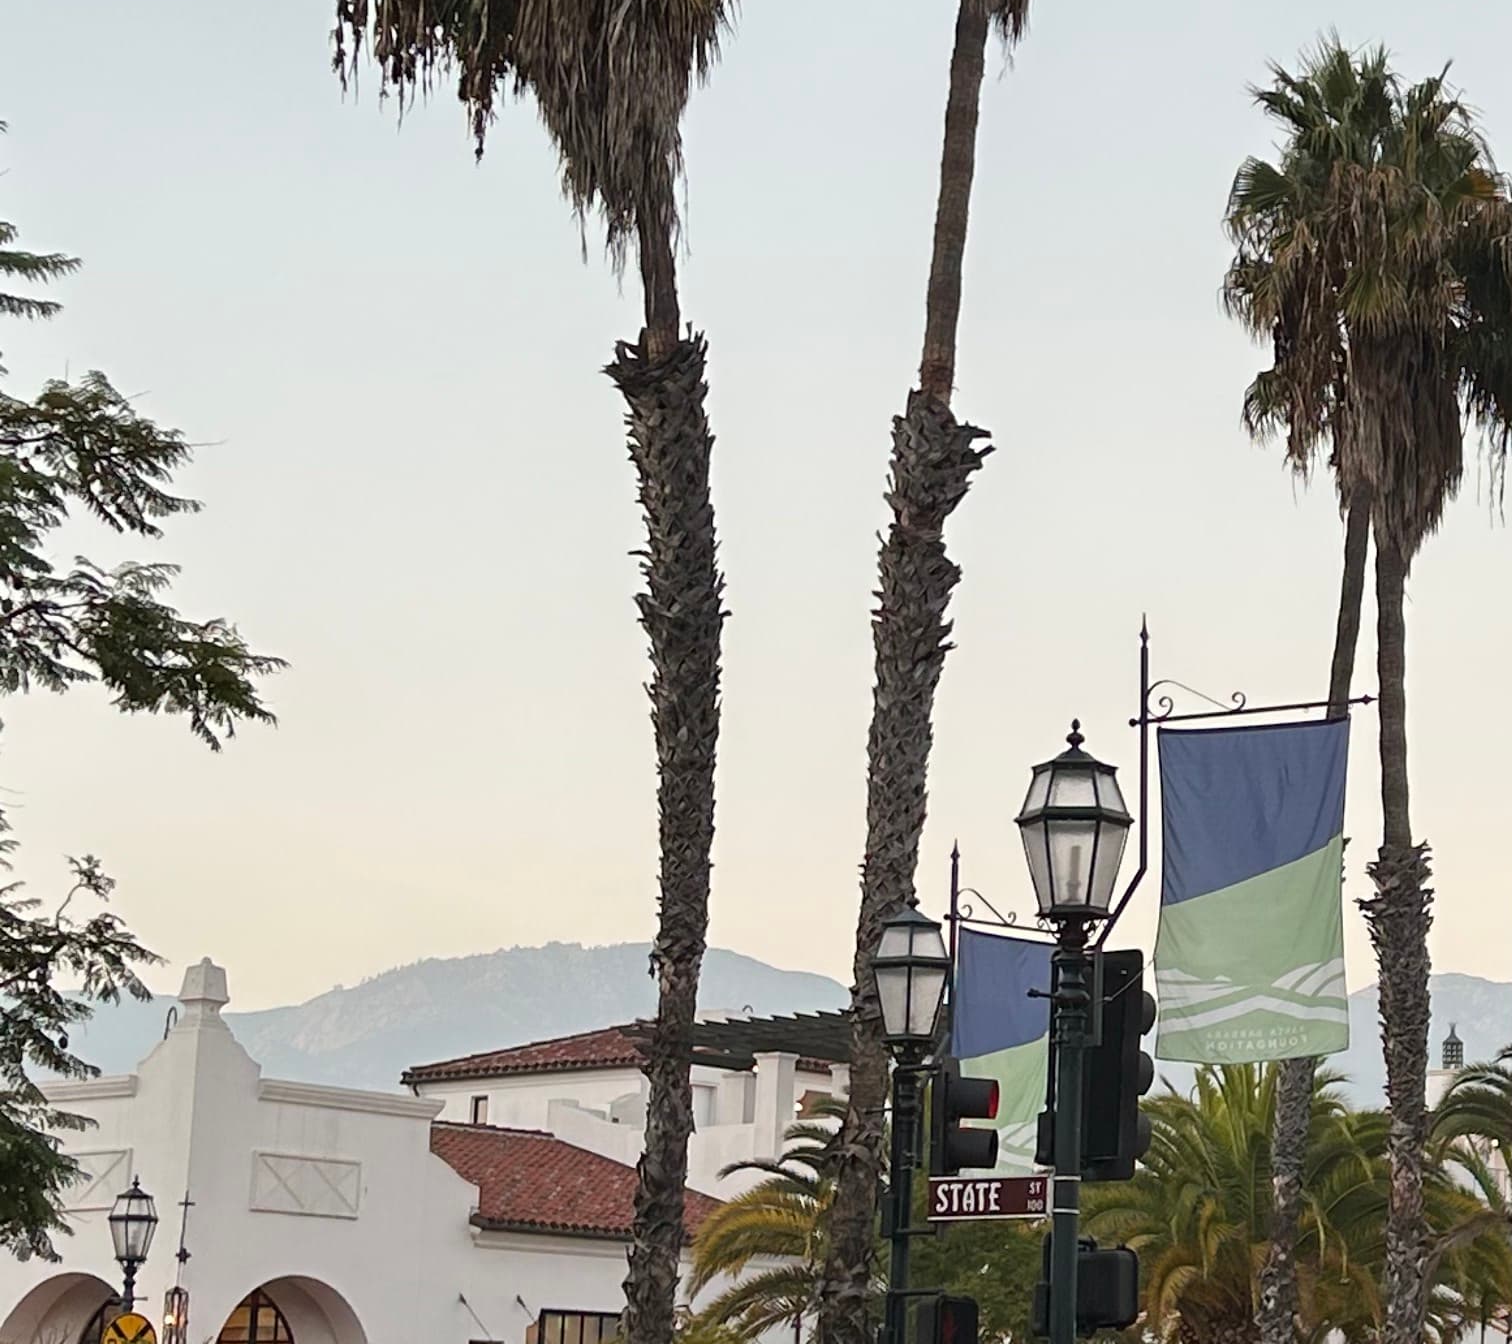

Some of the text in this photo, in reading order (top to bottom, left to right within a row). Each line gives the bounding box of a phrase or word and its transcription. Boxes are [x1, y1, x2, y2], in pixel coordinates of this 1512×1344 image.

[935, 1182, 1042, 1212] STATE ST
[1026, 1199, 1044, 1211] 100
